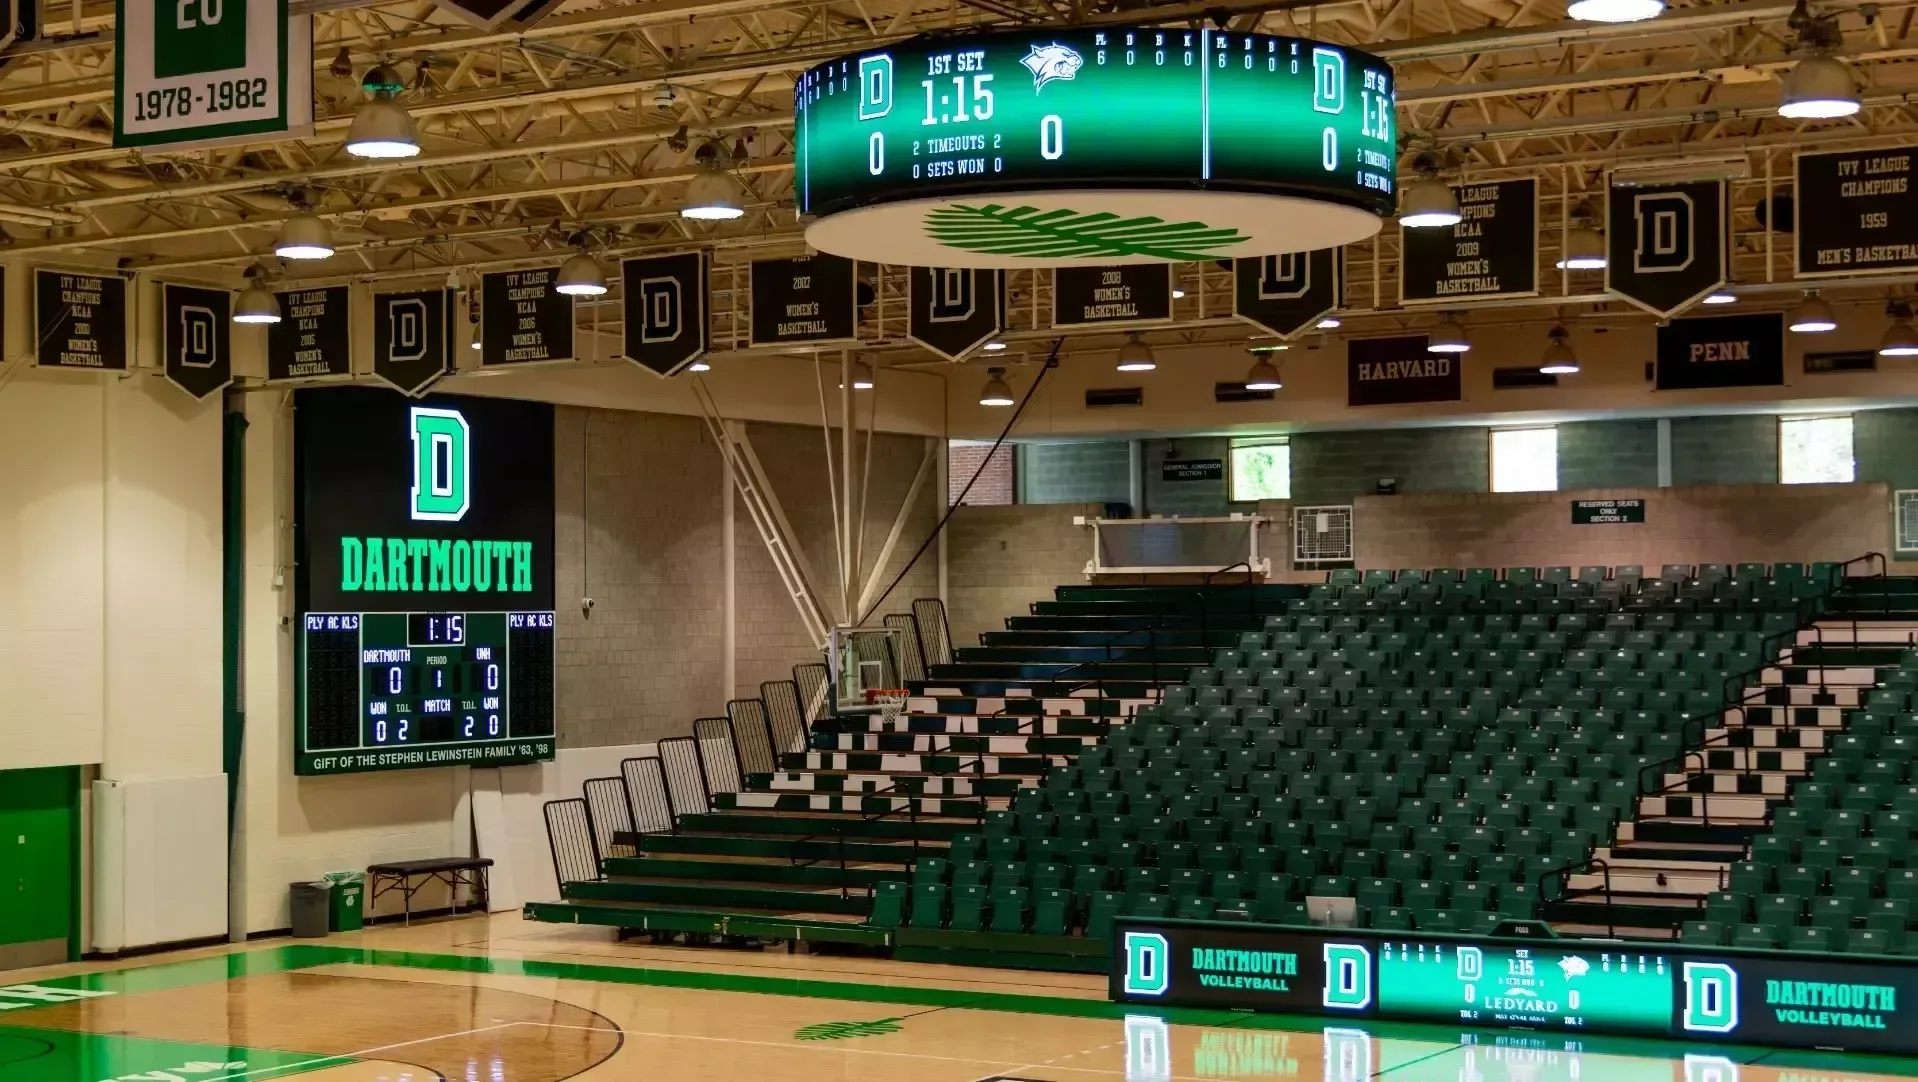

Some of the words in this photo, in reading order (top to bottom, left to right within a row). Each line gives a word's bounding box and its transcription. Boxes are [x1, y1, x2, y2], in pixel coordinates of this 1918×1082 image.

[1096, 34, 1106, 46] PL
[1127, 34, 1134, 46] D
[1156, 34, 1162, 46] B
[1184, 35, 1191, 47] K
[1216, 36, 1226, 48] PL
[1245, 38, 1251, 50] D
[928, 54, 952, 76] 1ST
[957, 52, 984, 72] SET
[1097, 50, 1105, 65] 6
[1127, 51, 1134, 66] 0
[1156, 51, 1163, 66] 0
[1184, 52, 1191, 66] 0
[1218, 54, 1225, 68] 6
[1245, 55, 1251, 70] 0
[1269, 57, 1275, 72] 0
[1291, 60, 1297, 74] 0
[859, 54, 893, 121] D
[1313, 48, 1344, 115] D
[1364, 70, 1376, 90] 1ST
[135, 78, 267, 122] 1978-1982
[922, 74, 994, 126] 1:15
[1361, 92, 1388, 142] 1:15
[913, 140, 919, 156] 2
[928, 135, 985, 154] TIMEOUTS
[994, 134, 1001, 149] 2
[1040, 114, 1063, 160] 0
[869, 132, 884, 176] 0
[1322, 127, 1337, 171] 0
[913, 164, 919, 179] 0
[927, 160, 954, 178] SETS
[958, 158, 984, 175] WON
[994, 157, 1002, 173] 0
[1838, 160, 1860, 176] IVY
[1865, 156, 1909, 174] LEAGUE
[1364, 172, 1378, 189] SETS
[1841, 177, 1908, 197] CHAMPIONS
[1461, 186, 1500, 203] LEAGUE
[1460, 204, 1495, 220] MPIONS
[1860, 212, 1887, 228] 1959
[1454, 222, 1482, 237] NCAA
[1634, 192, 1694, 273] D
[1456, 242, 1479, 256] 2009
[1818, 247, 1850, 264] MEN'S
[1856, 244, 1918, 262] BASKETBA
[1447, 258, 1488, 276] WOMEN'S
[60, 276, 74, 289] IVY
[76, 278, 102, 291] LEAGUE
[506, 274, 519, 286] IVY
[522, 272, 548, 284] LEAGUE
[793, 276, 811, 290] 2007
[1102, 271, 1121, 285] 2008
[1436, 277, 1500, 294] BASKETBALL
[62, 290, 101, 304] CHAMPIONS
[288, 294, 300, 305] IVY
[303, 291, 327, 303] LEAGUE
[508, 286, 545, 300] CHAMPIONS
[1094, 285, 1130, 302] WOMEN'S
[72, 305, 92, 318] NCAA
[291, 304, 325, 317] CHAMPIONS
[517, 301, 536, 314] NCAA
[641, 276, 682, 343] D
[786, 302, 819, 317] WOMEN'S
[1084, 303, 1138, 319] BASKETBALL
[74, 322, 90, 335] 2000
[300, 319, 318, 330] NCAA
[389, 298, 427, 361] D
[519, 317, 535, 330] 2006
[778, 320, 827, 336] BASKETBALL
[68, 338, 97, 352] WOMEN'S
[181, 305, 216, 368] D
[300, 334, 315, 346] 2005
[512, 332, 542, 346] WOMEN'S
[60, 352, 104, 366] BASKETBALL
[295, 348, 322, 362] WOMEN'S
[505, 346, 549, 361] BASKETBALL
[1689, 340, 1749, 362] PENN
[288, 361, 330, 376] BASKETBALL
[1358, 359, 1450, 381] HARVARD
[411, 406, 470, 522] D
[342, 537, 532, 592] DARTMOUTH
[307, 617, 324, 630] PLY
[328, 616, 339, 629] AC
[342, 616, 358, 629] KLS
[427, 616, 462, 642] 1:15
[510, 614, 524, 627] PLY
[527, 614, 537, 627] AC
[539, 614, 552, 627] KLS
[364, 649, 411, 663] DARTMOUTH
[426, 656, 447, 665] PERIOD
[476, 648, 491, 660] UNH
[389, 667, 401, 694] 0
[437, 670, 442, 688] 1
[487, 665, 498, 690] 0
[370, 702, 387, 715] WON
[424, 700, 450, 712] MATCH
[484, 697, 498, 709] WON
[376, 720, 386, 742] 0
[399, 720, 408, 740] 2
[465, 716, 474, 737] 2
[489, 715, 498, 735] 0
[313, 757, 336, 770] GIFT
[340, 756, 354, 767] OF
[356, 754, 377, 766] THE
[379, 752, 424, 765] STEPHEN
[426, 747, 482, 762] LEWINSTEIN
[484, 745, 516, 758] FAMILY
[518, 745, 533, 756] '63,
[536, 744, 548, 754] '98
[1192, 947, 1297, 976] DARTMOUTH
[1516, 950, 1529, 958] SET
[1124, 932, 1168, 995] D
[1456, 946, 1482, 981] D
[1508, 959, 1534, 976] 1:15
[1200, 974, 1289, 992] VOLLEYBALL
[1323, 943, 1370, 1009] D
[1465, 984, 1475, 1003] 0
[1569, 990, 1580, 1009] 0
[1684, 962, 1737, 1032] D
[1766, 979, 1895, 1011] DARTMOUTH
[1484, 996, 1558, 1012] LEDYARD
[1578, 1017, 1584, 1025] 2
[1776, 1008, 1886, 1029] VOLLEYBALL
